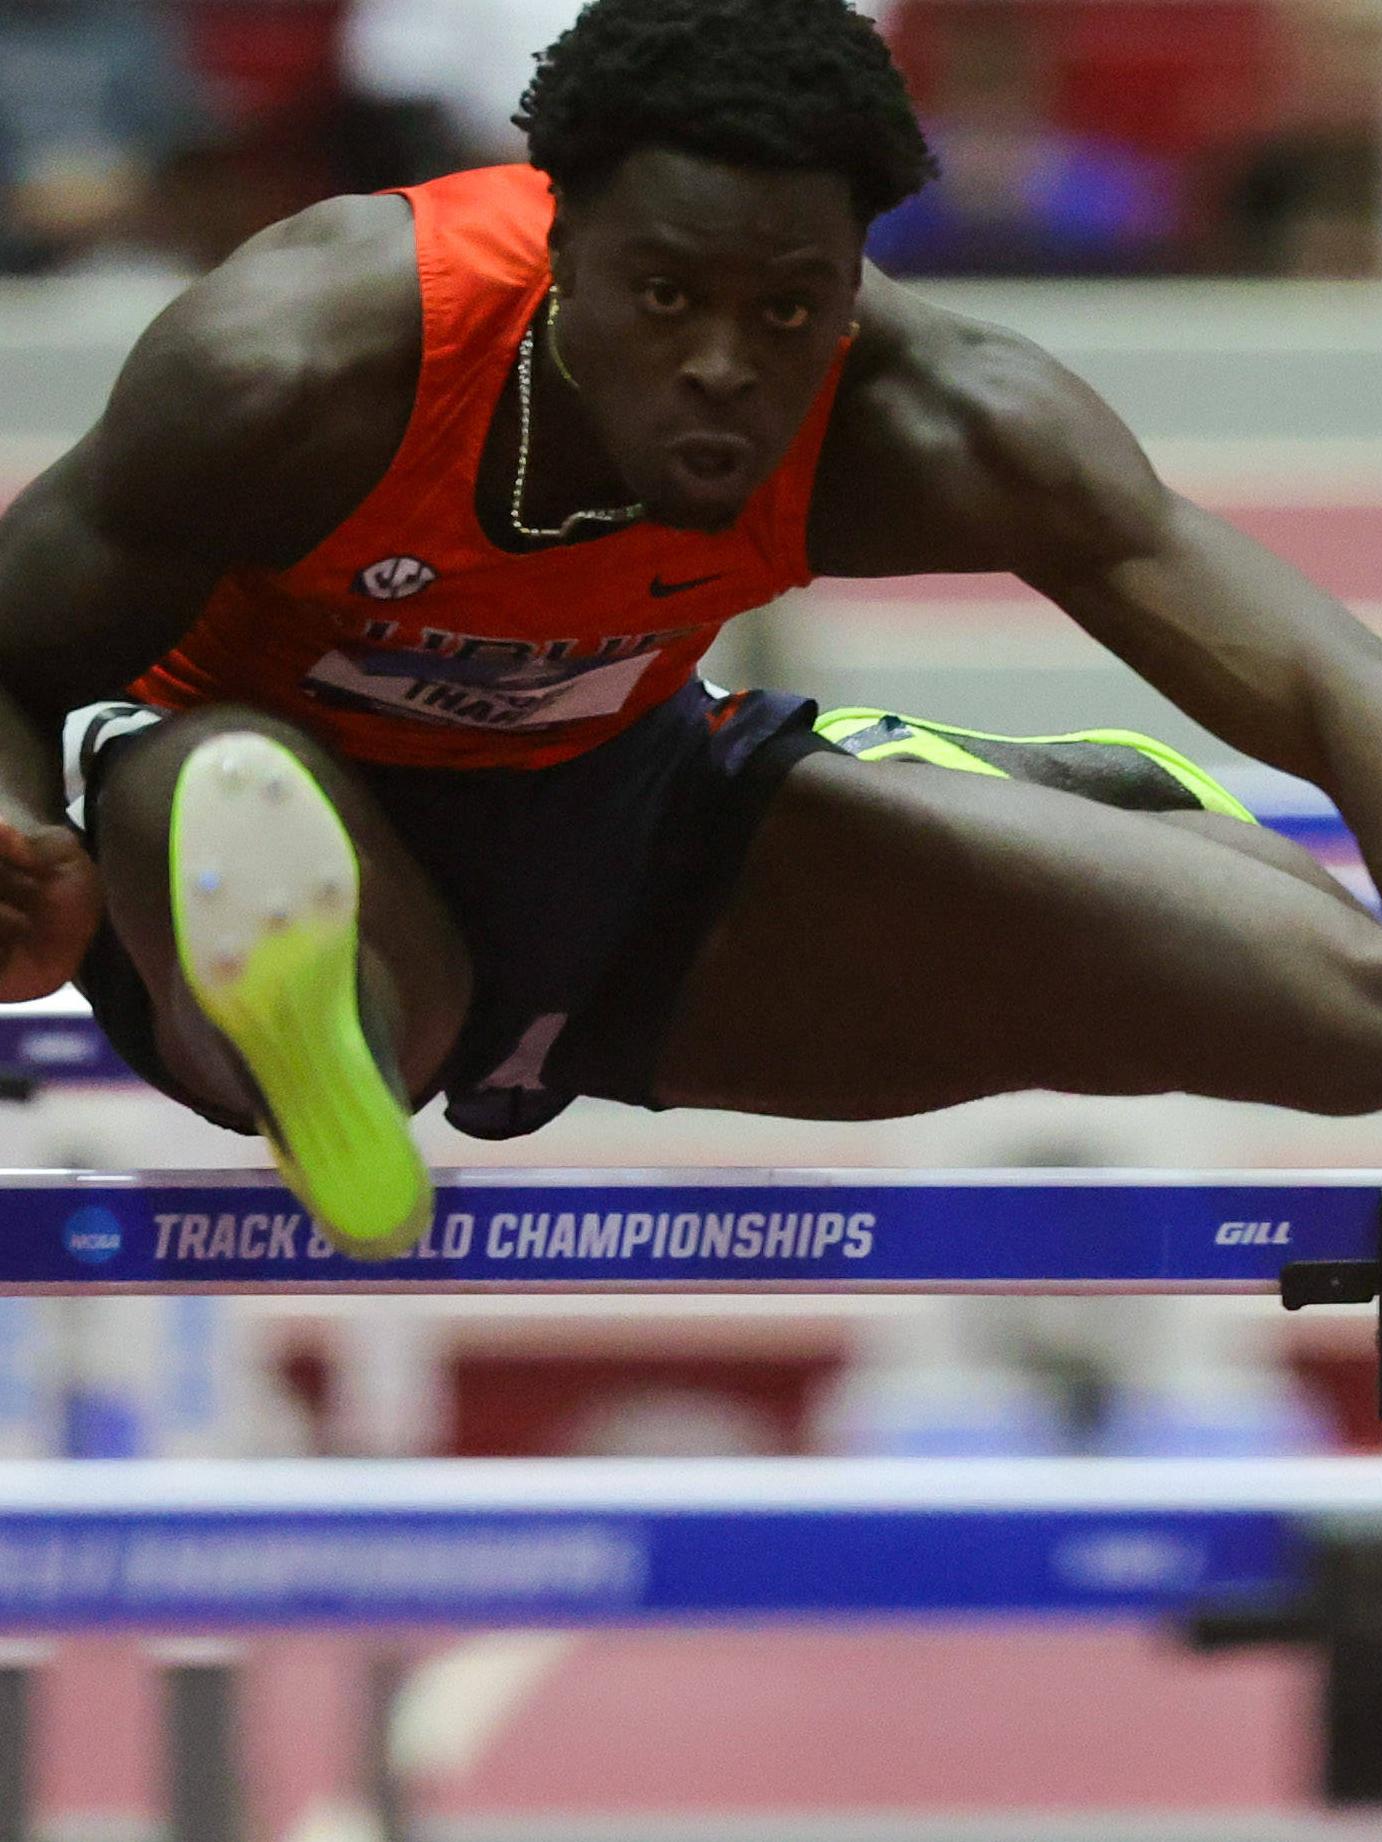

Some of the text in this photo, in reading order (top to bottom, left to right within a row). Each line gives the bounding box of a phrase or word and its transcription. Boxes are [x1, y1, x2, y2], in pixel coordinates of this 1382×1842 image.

[153, 1213, 300, 1259] TRACK
[486, 1212, 876, 1259] CHAMPIONSHIPS
[1214, 1221, 1292, 1245] GILL
